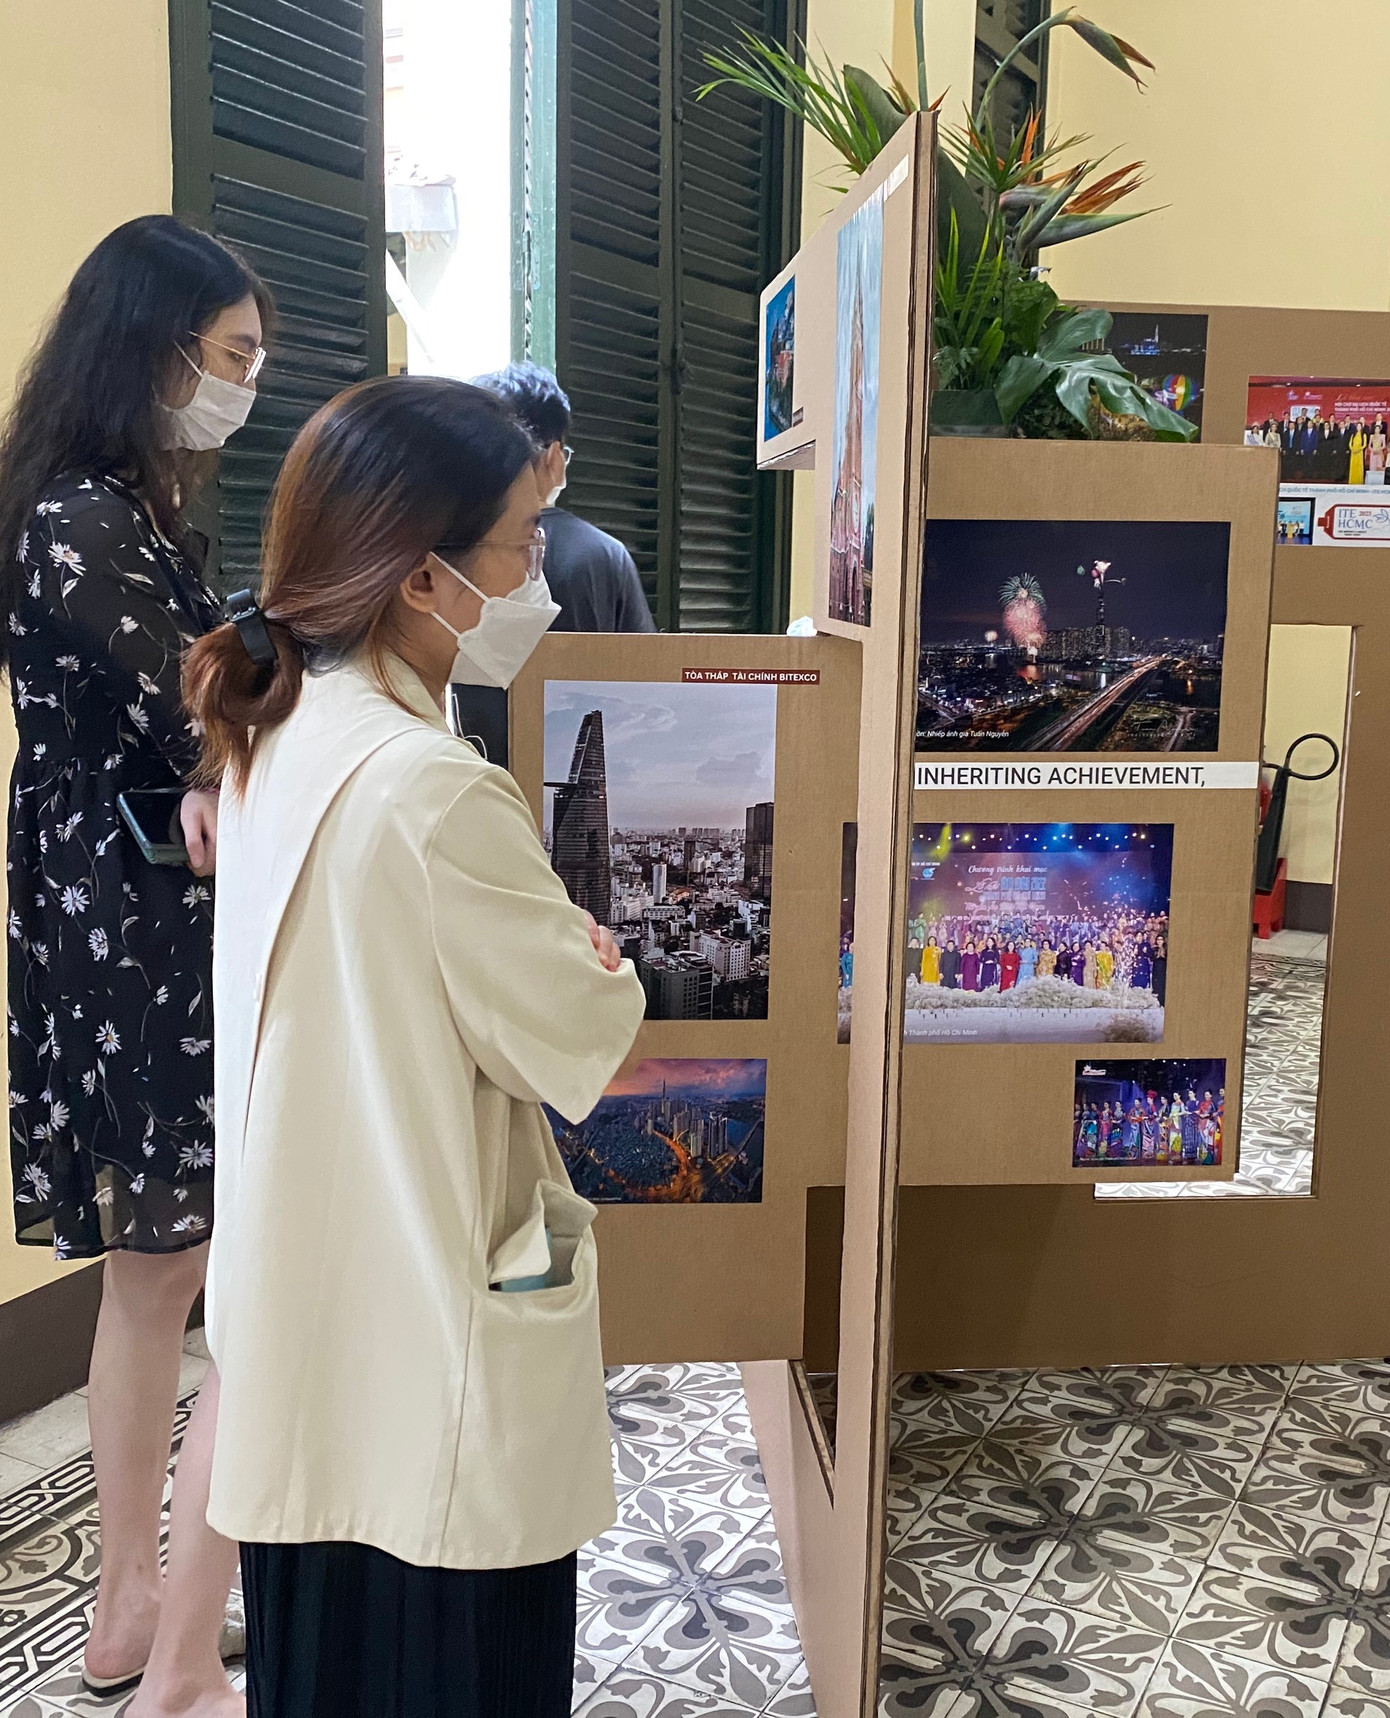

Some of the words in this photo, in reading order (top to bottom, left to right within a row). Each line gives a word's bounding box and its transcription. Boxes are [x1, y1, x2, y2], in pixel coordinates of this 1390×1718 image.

[1338, 508, 1356, 518] ITE
[1338, 518, 1373, 530] HCMC
[684, 670, 703, 680] TÒA
[704, 670, 729, 680] THÁP
[732, 671, 746, 680] TÀI
[748, 671, 777, 681] CHÍNH
[779, 673, 817, 682] BITEXCO
[917, 766, 1041, 785] INHERITING
[1047, 766, 1206, 787] ACHIEVEMENT,
